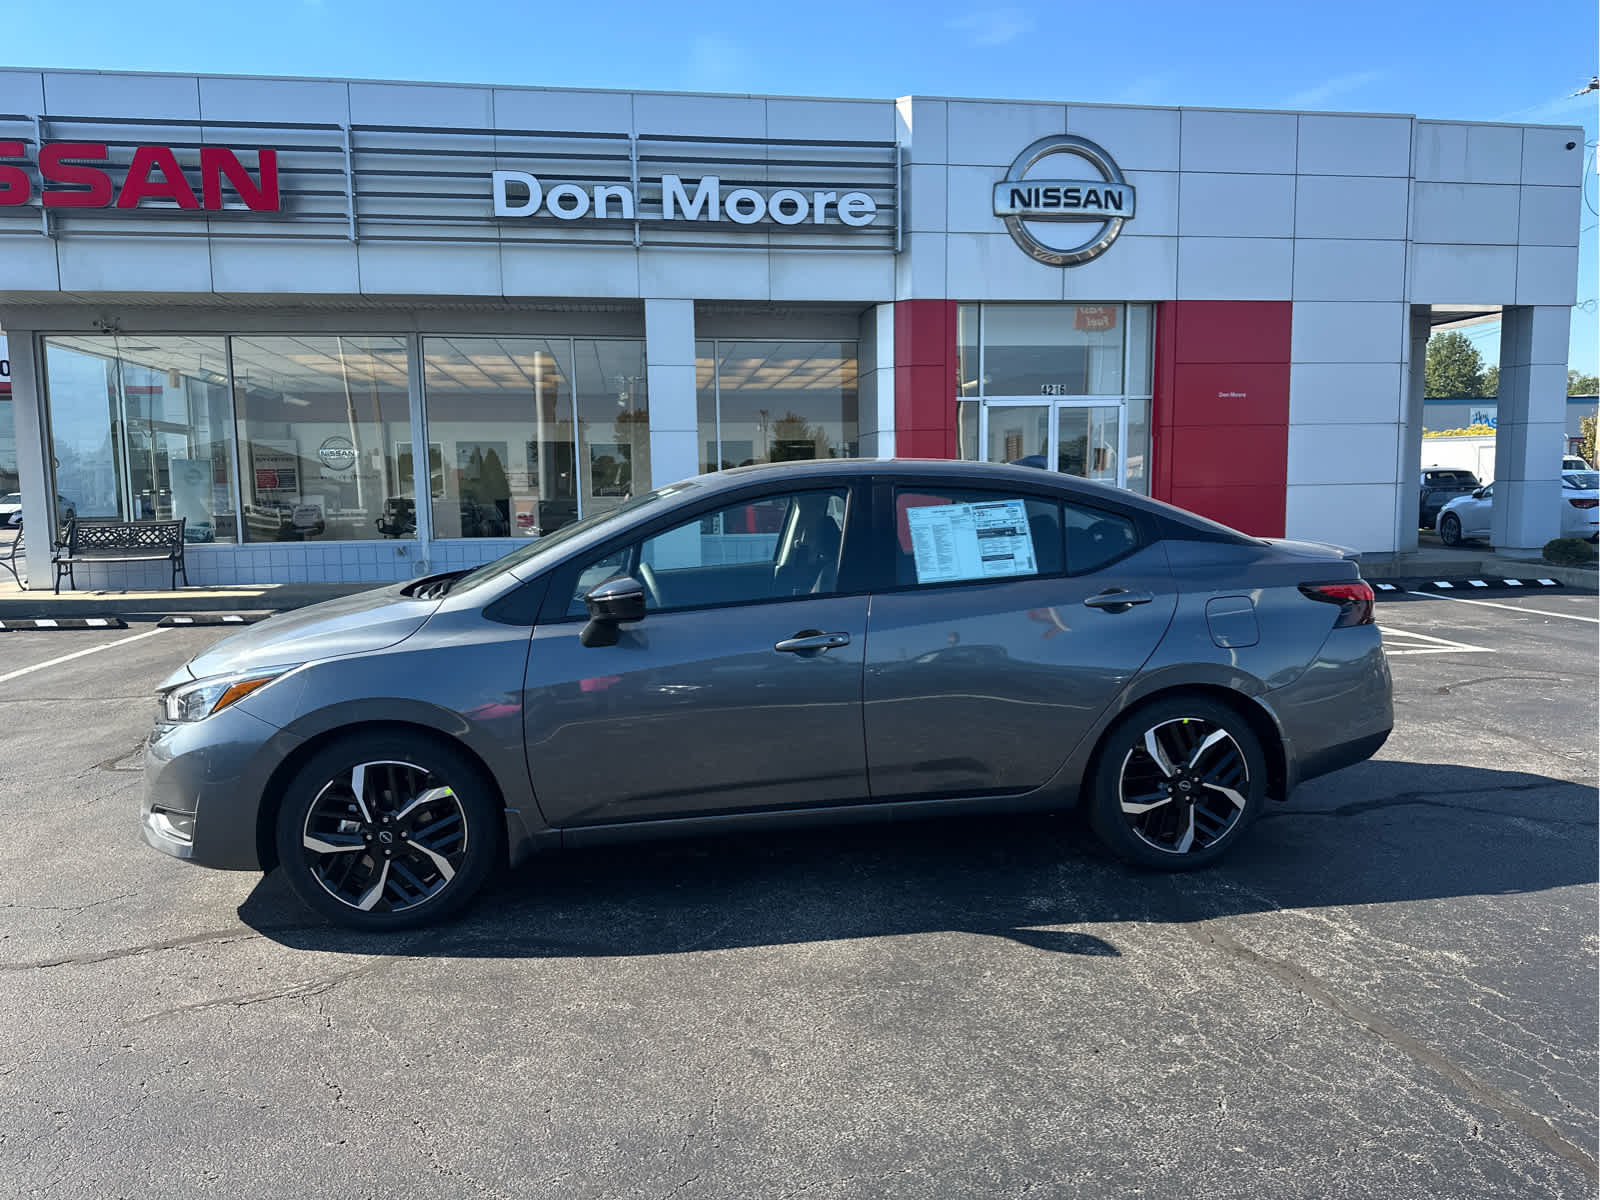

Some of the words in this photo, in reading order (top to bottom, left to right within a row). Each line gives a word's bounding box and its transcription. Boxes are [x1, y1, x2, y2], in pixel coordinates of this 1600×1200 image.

[492, 170, 634, 219] Don
[661, 174, 878, 226] Moore
[1009, 187, 1123, 210] NISSAN
